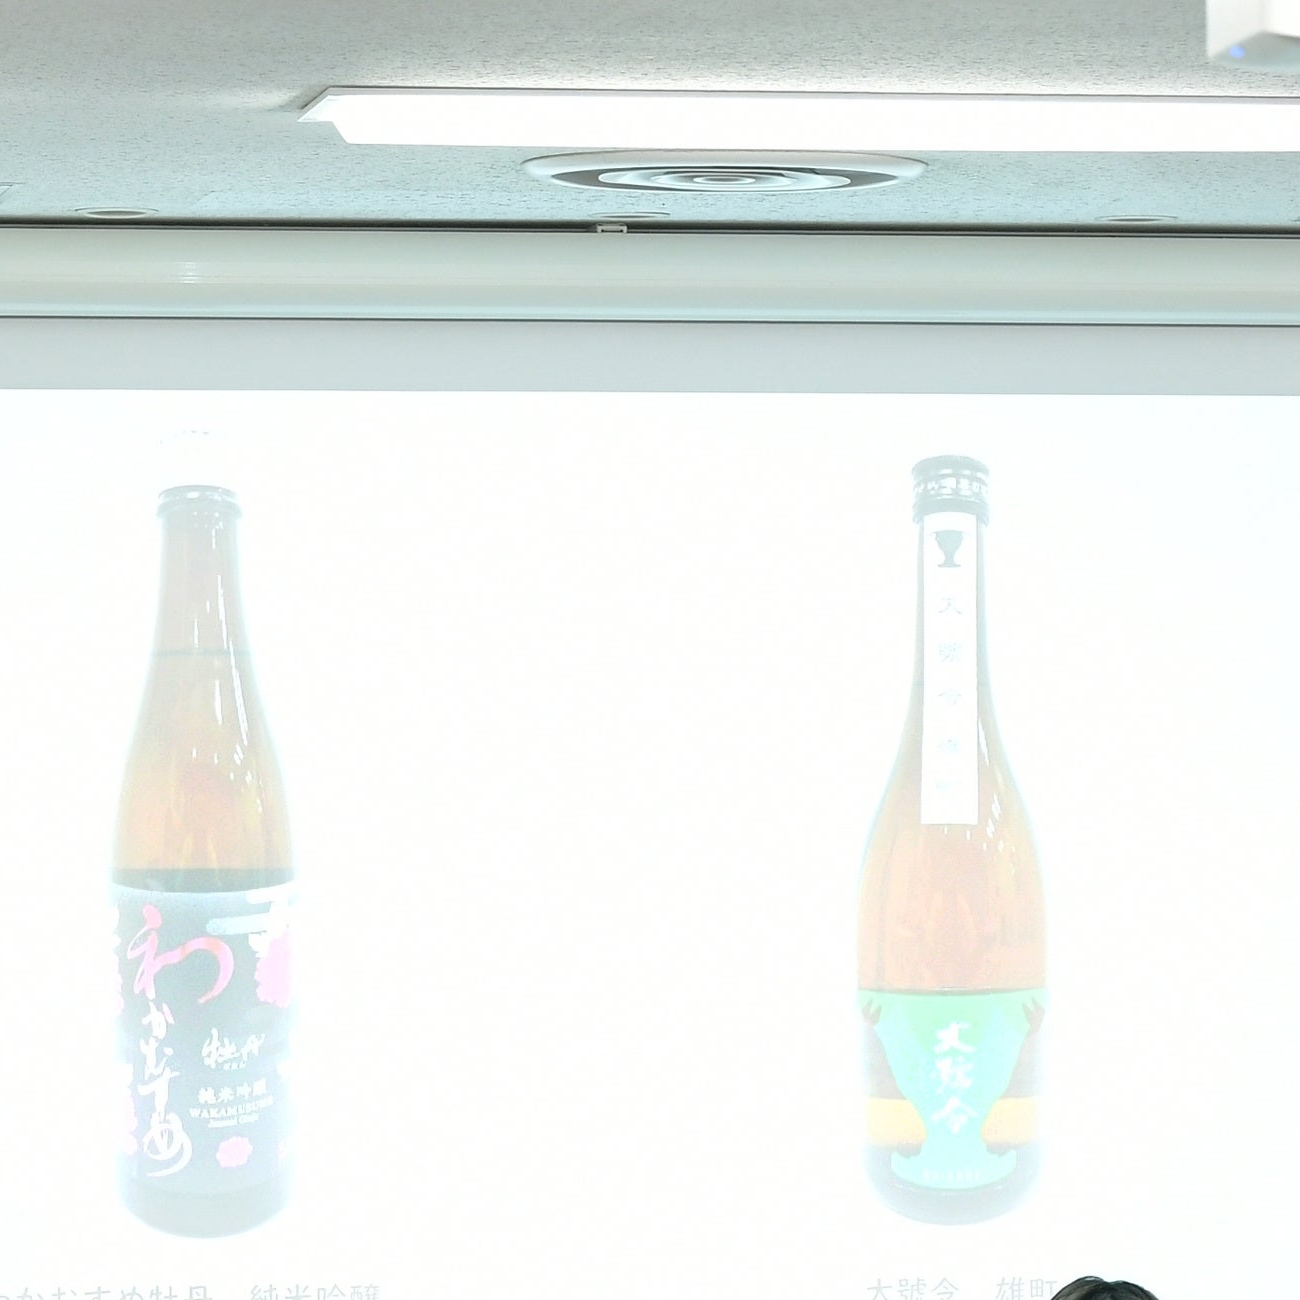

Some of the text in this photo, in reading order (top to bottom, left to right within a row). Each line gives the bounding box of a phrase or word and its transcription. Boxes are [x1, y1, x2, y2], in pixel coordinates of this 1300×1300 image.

[127, 904, 235, 1177] わかむすめ
